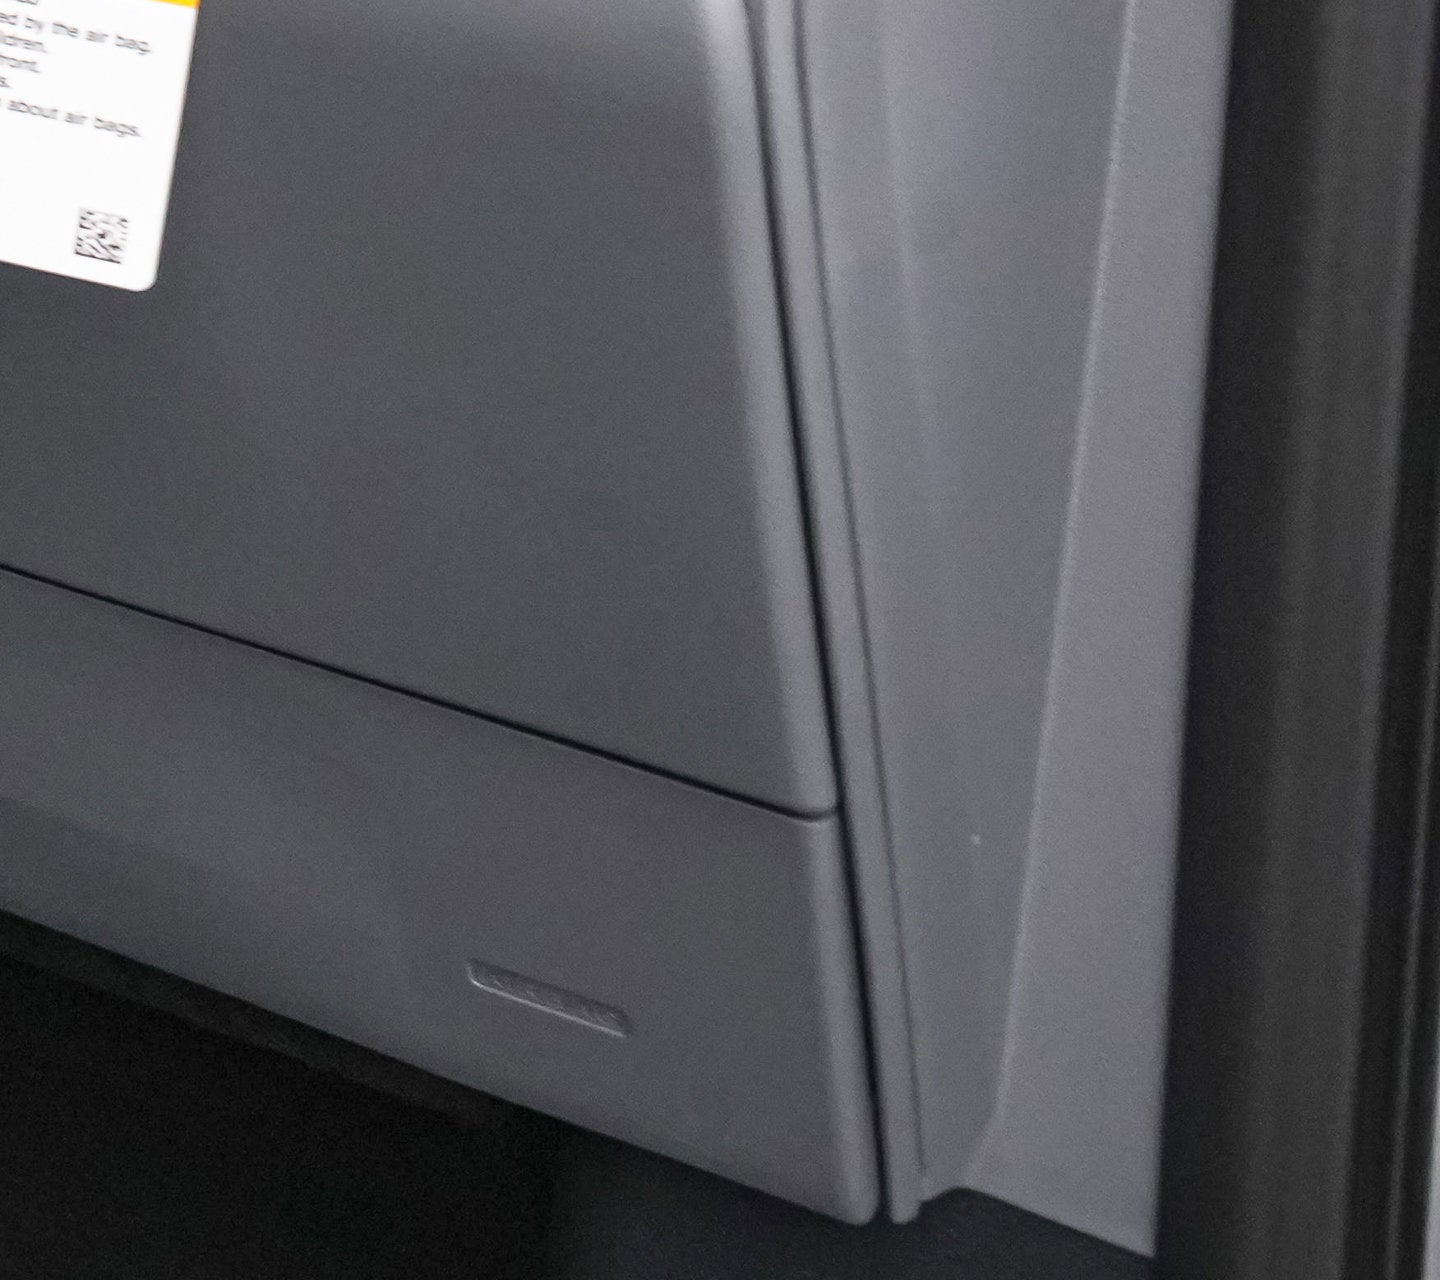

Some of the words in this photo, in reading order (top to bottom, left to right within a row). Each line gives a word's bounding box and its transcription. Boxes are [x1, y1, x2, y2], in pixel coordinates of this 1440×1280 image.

[24, 17, 44, 31] by
[52, 22, 79, 38] the
[85, 31, 109, 43] air
[115, 35, 151, 55] bag.
[7, 100, 58, 120] about
[64, 112, 88, 125] air
[94, 117, 141, 137] bags.
